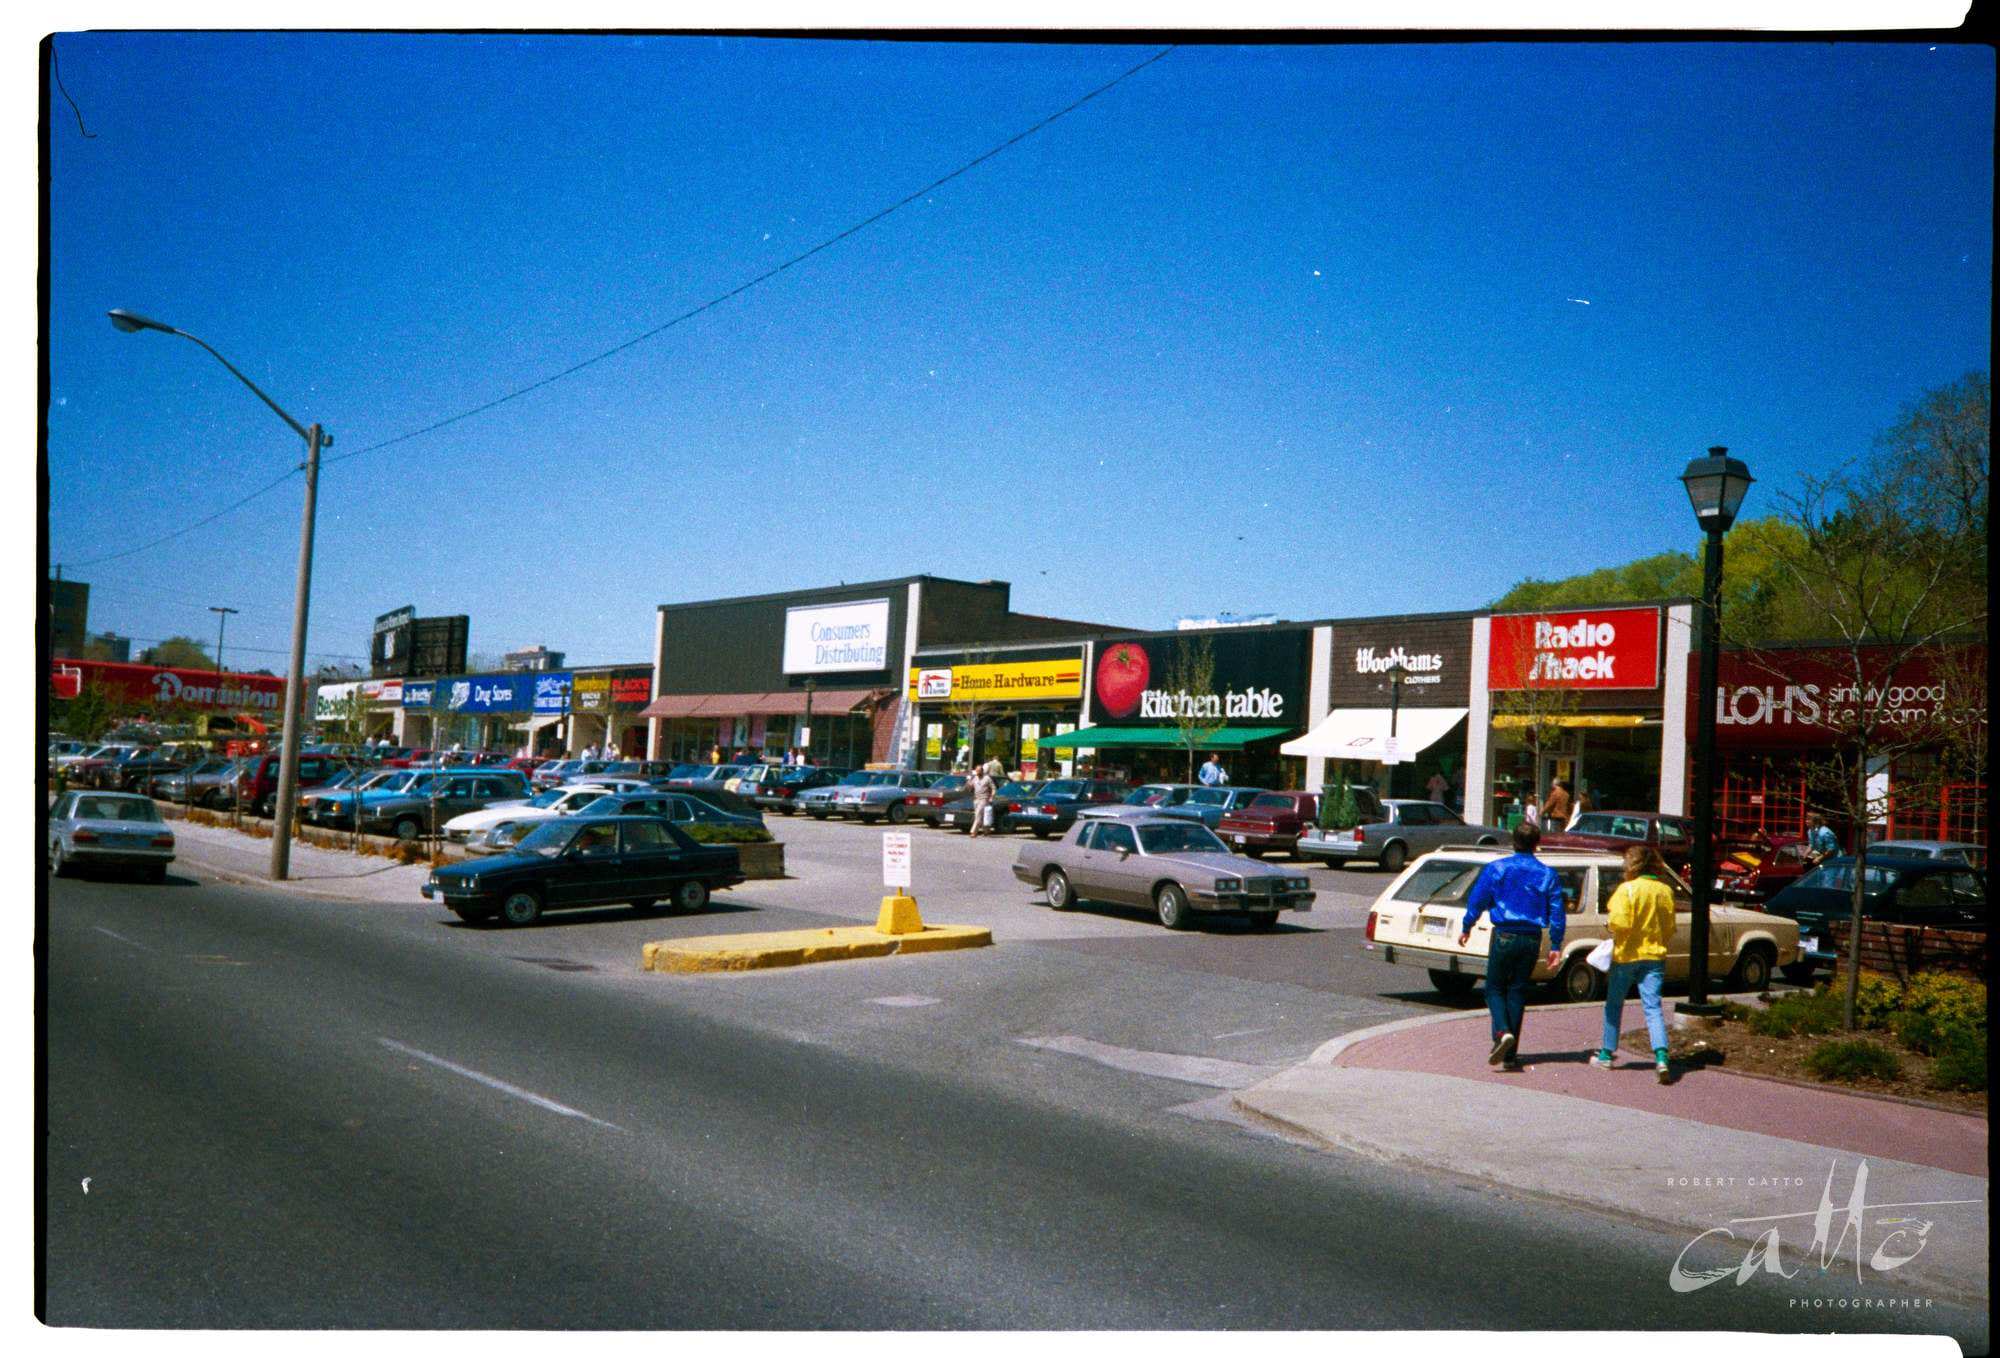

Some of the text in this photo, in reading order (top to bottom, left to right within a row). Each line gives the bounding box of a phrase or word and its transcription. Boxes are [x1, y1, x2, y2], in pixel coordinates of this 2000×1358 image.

[811, 622, 871, 642] Consumers
[1535, 619, 1615, 649] Radio
[815, 642, 884, 665] Distributing
[1356, 646, 1442, 673] Woodhams
[1529, 651, 1615, 680] Shack
[152, 672, 277, 708] Dominion
[960, 673, 1054, 689] Home Hardware
[1888, 680, 1946, 708] good
[475, 685, 491, 706] Drug
[1140, 686, 1284, 718] kitchen table
[1716, 684, 1821, 724] LOH'S
